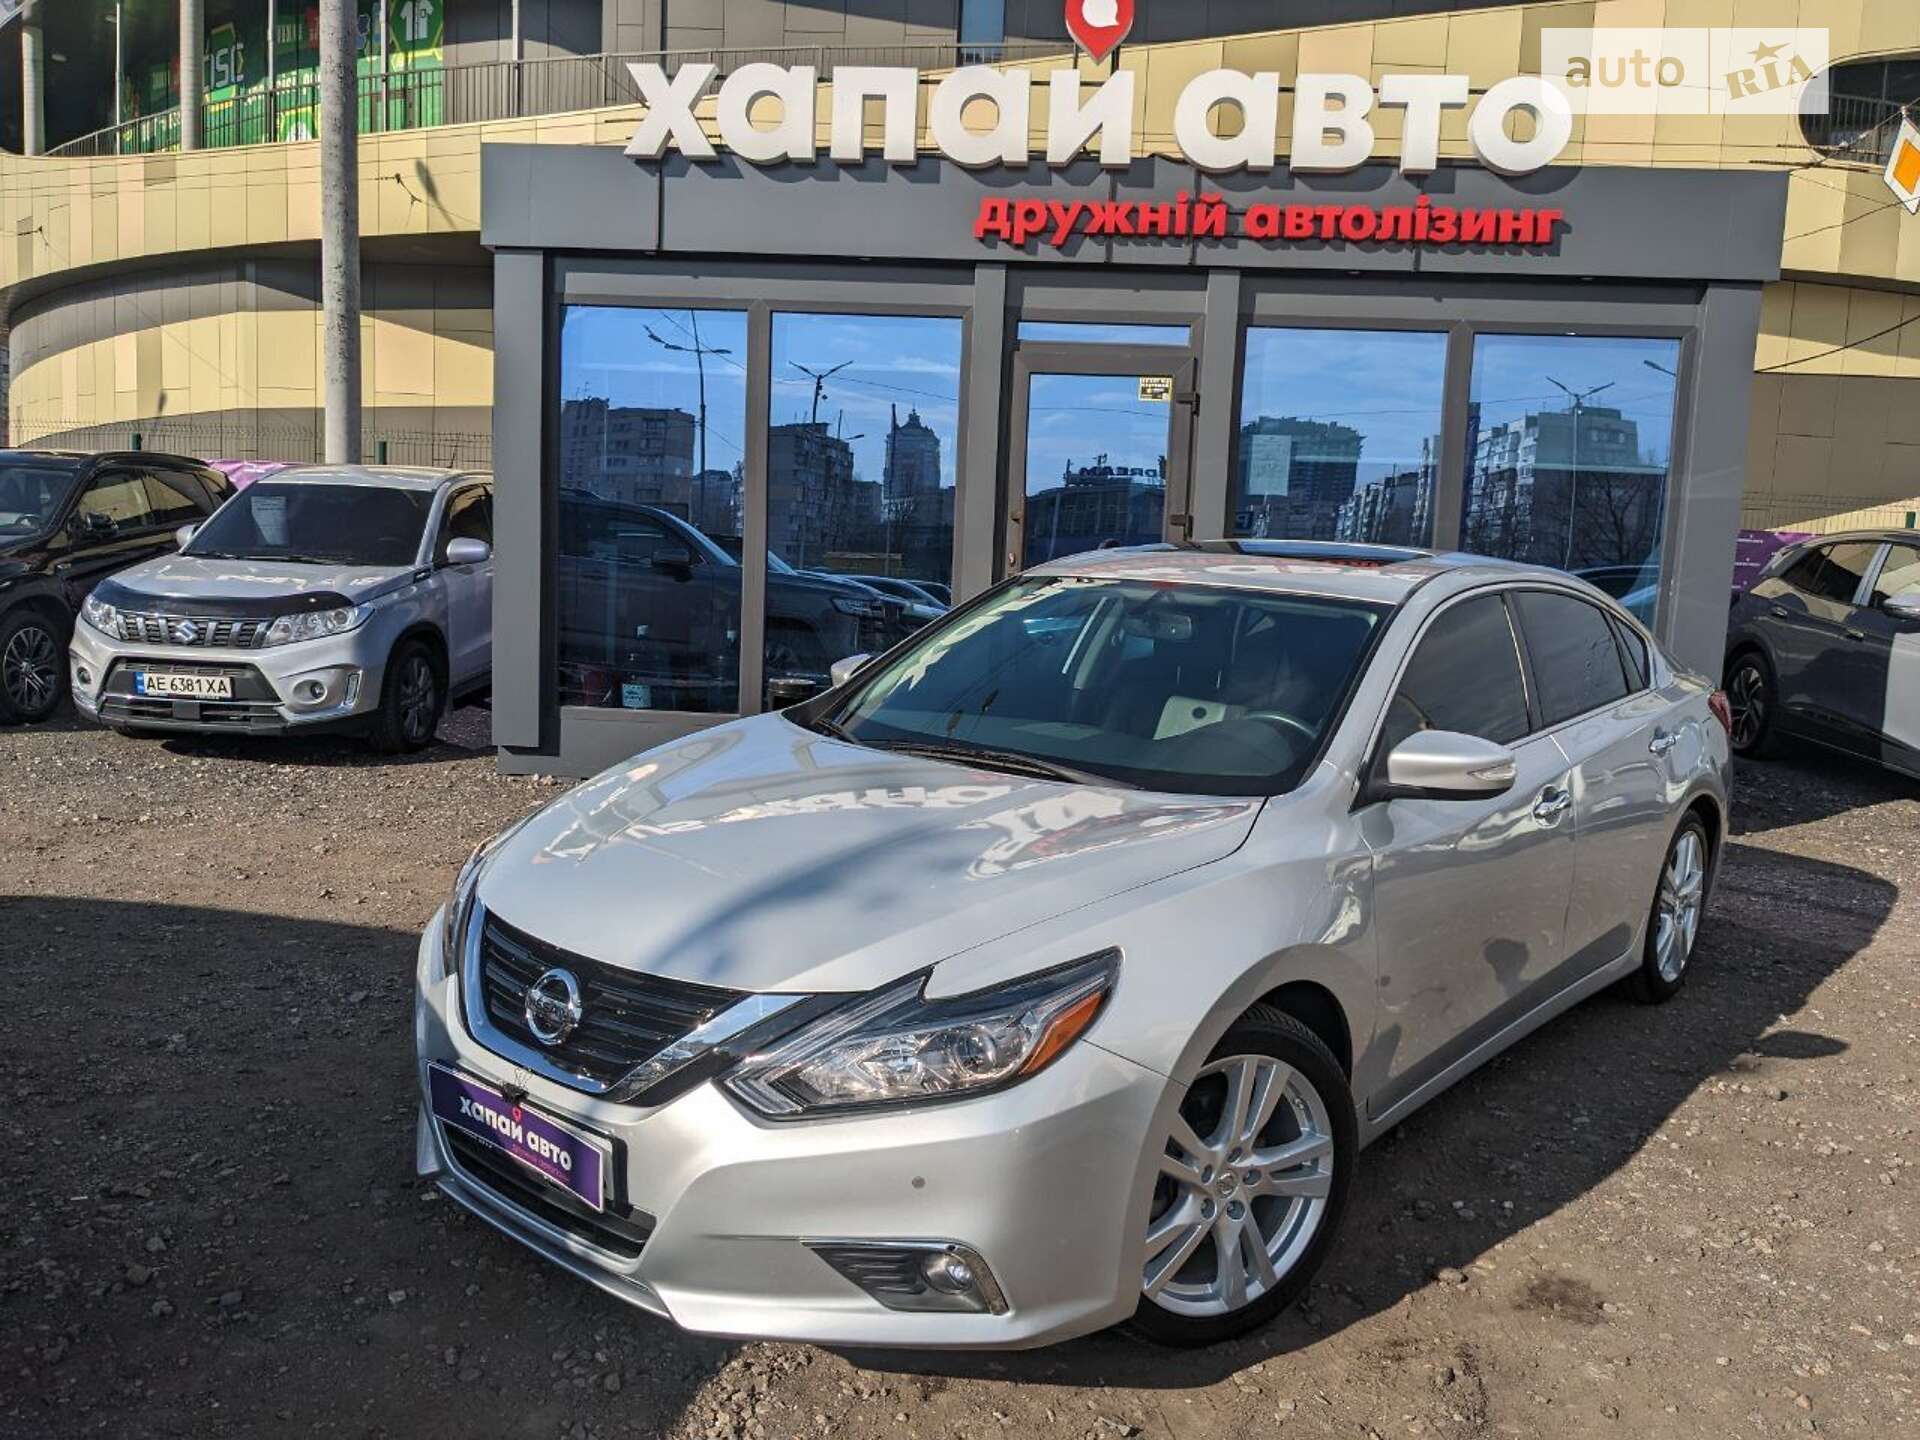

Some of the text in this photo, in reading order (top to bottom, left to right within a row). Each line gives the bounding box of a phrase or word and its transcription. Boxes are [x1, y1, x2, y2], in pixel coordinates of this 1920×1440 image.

[1174, 68, 1573, 176] авто
[974, 190, 1562, 246] дружній автолізинг
[170, 677, 203, 693] 6381
[526, 1131, 573, 1171] авто
